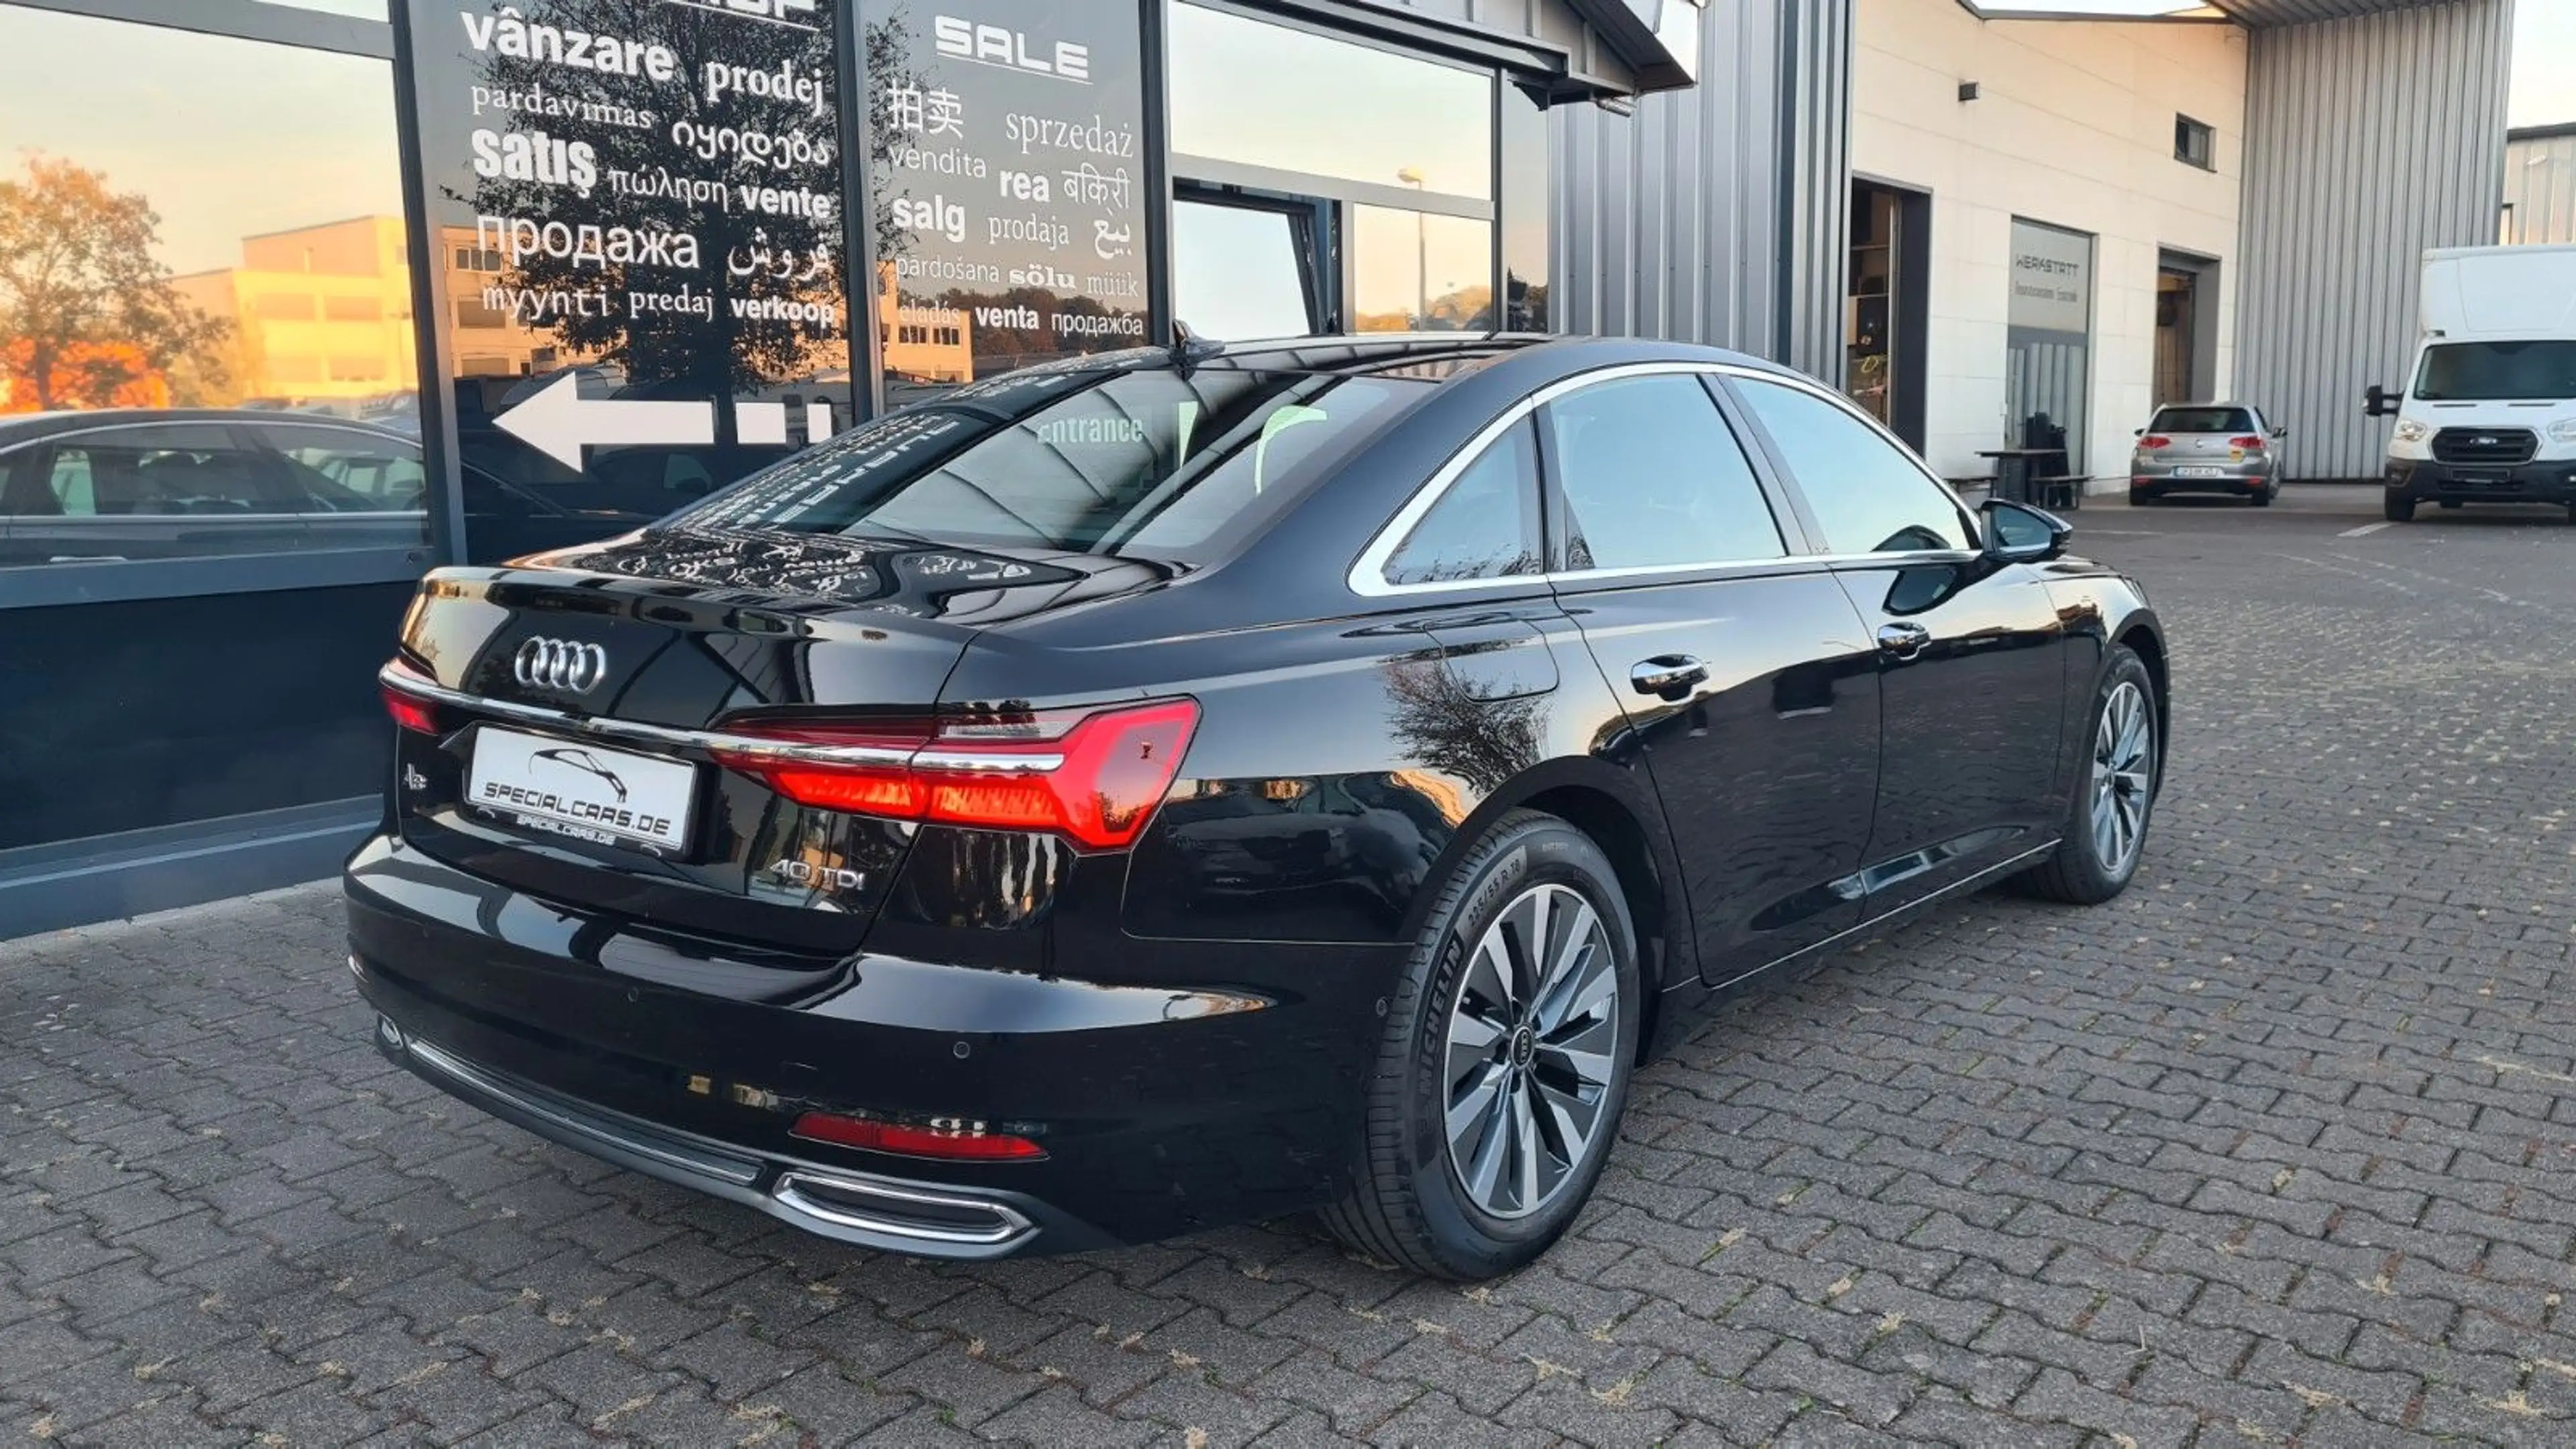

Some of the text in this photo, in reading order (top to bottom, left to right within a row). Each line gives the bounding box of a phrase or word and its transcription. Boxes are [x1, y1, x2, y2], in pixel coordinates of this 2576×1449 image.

[461, 6, 674, 81] vânzare
[935, 15, 1089, 80] SALE
[471, 83, 653, 130] pardavimas
[706, 59, 824, 118] prodej
[887, 79, 964, 139] 拍卖
[1006, 114, 1134, 158] sprzedaż
[471, 128, 597, 199] satış
[887, 145, 987, 177] vendita
[610, 166, 729, 214] πώληση
[739, 184, 830, 219] vente
[999, 169, 1051, 203] rea
[893, 195, 965, 243] salg
[987, 213, 1070, 251] prodaja
[477, 215, 700, 269] продажа
[1008, 264, 1076, 289] sölu
[1087, 272, 1138, 298] müük
[483, 286, 608, 320] myynti
[630, 283, 714, 323] predaj
[731, 298, 835, 329] verkoop
[975, 305, 1040, 331] venta
[1051, 311, 1144, 337] продажба
[484, 781, 671, 837] SPECIALCARS.DE
[770, 859, 865, 891] 40 TDI
[1417, 932, 1465, 1098] MICHELIN
